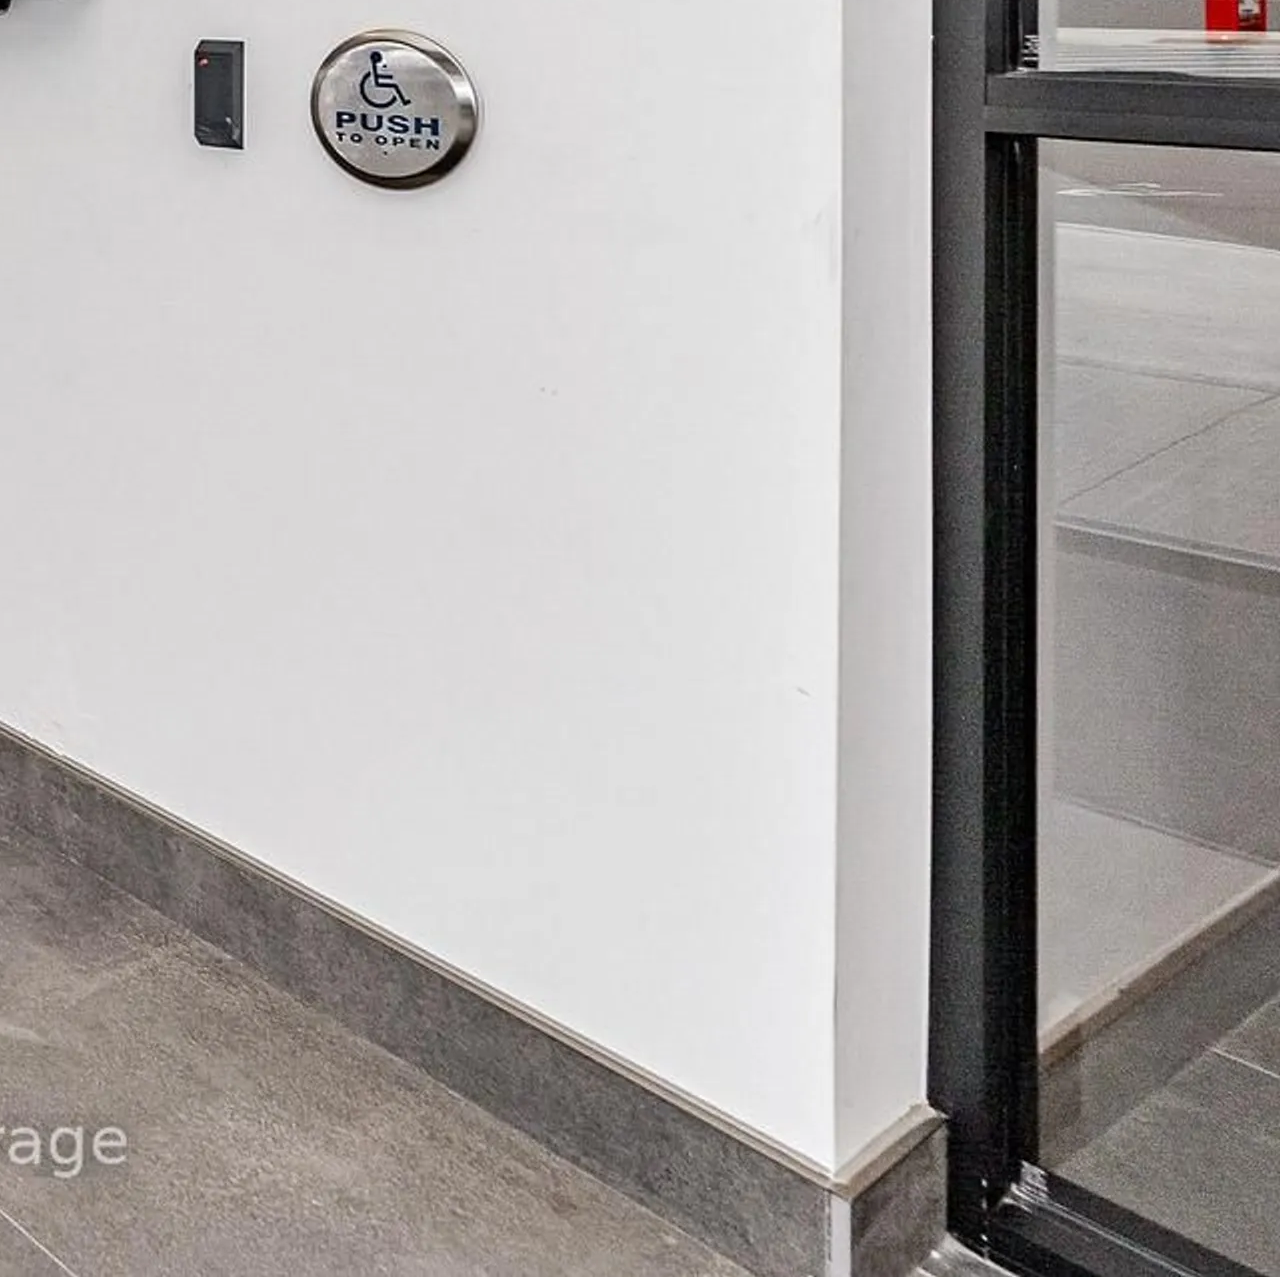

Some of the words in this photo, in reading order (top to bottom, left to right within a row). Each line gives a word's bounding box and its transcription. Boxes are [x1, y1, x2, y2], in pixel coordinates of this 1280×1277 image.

[336, 111, 439, 136] PUSH
[336, 132, 362, 143] TO
[375, 135, 439, 150] OPEN
